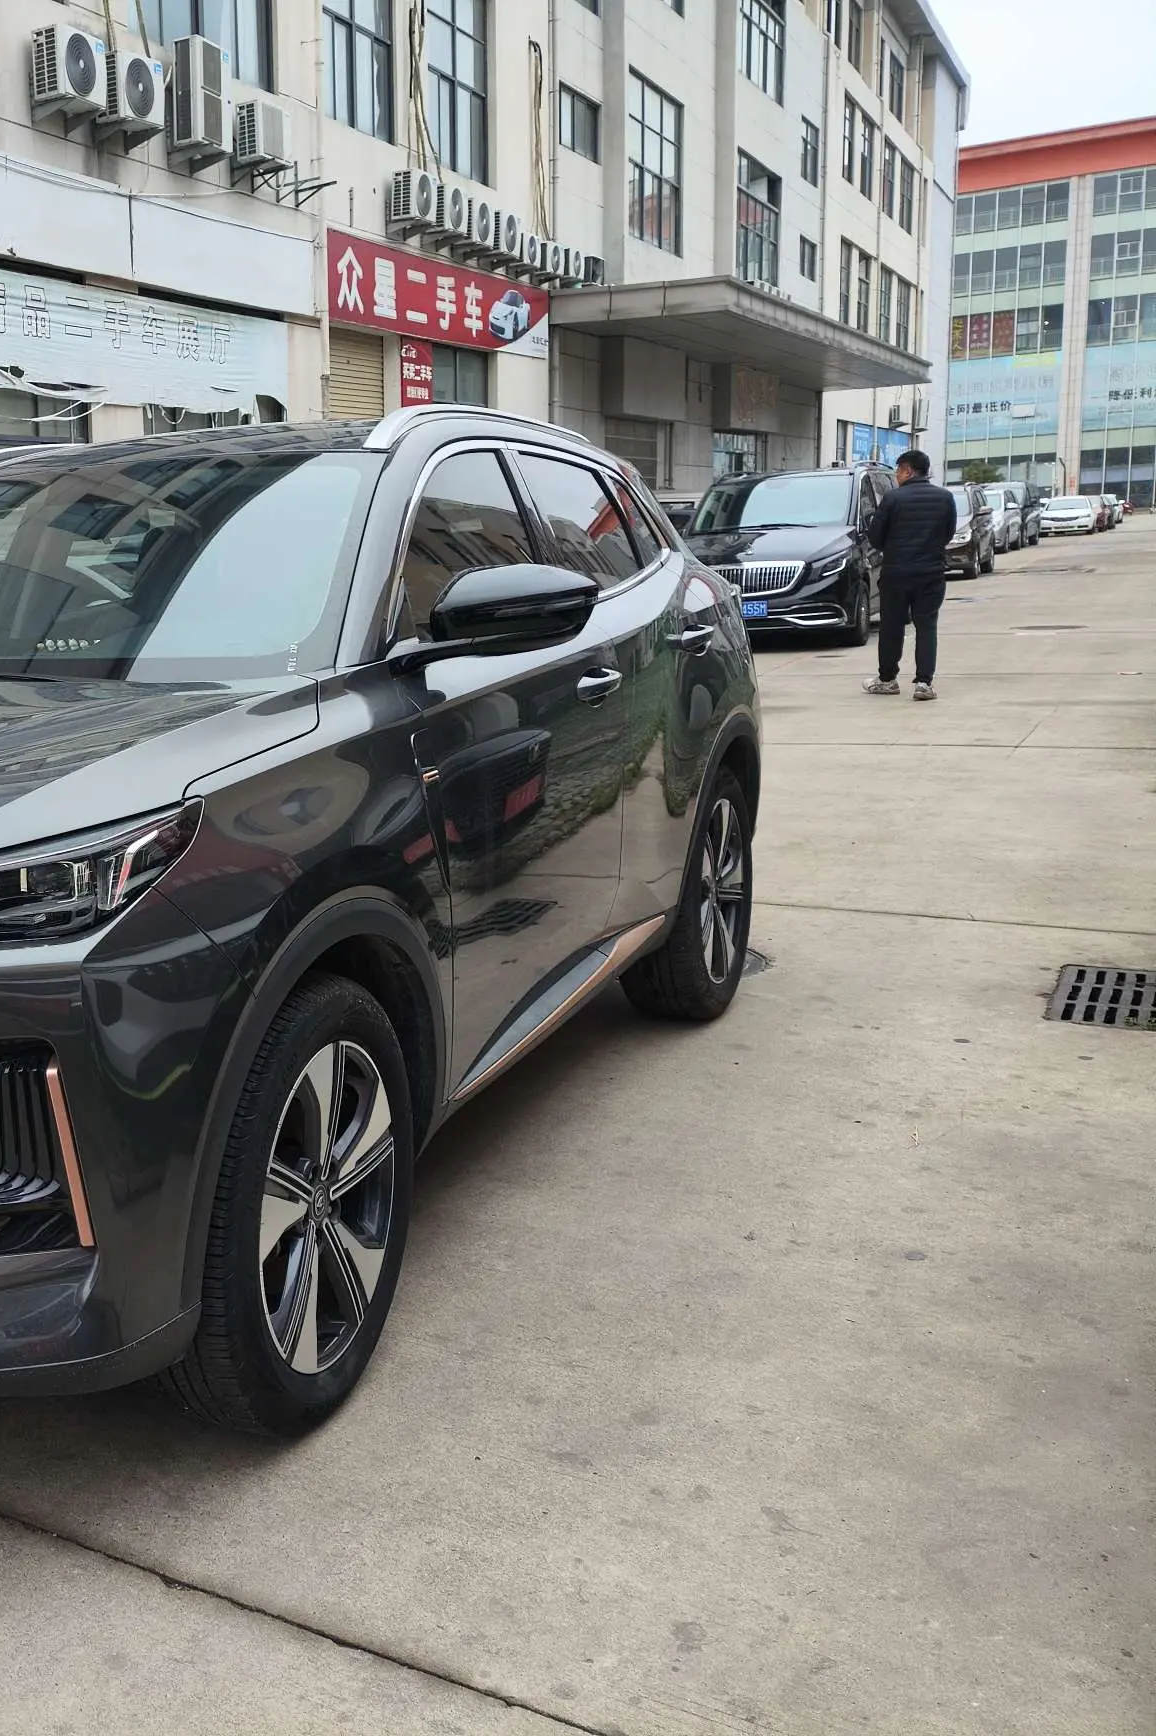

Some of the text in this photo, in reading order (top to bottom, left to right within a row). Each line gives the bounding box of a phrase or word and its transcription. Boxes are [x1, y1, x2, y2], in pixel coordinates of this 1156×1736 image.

[337, 246, 484, 338] 众星二手车
